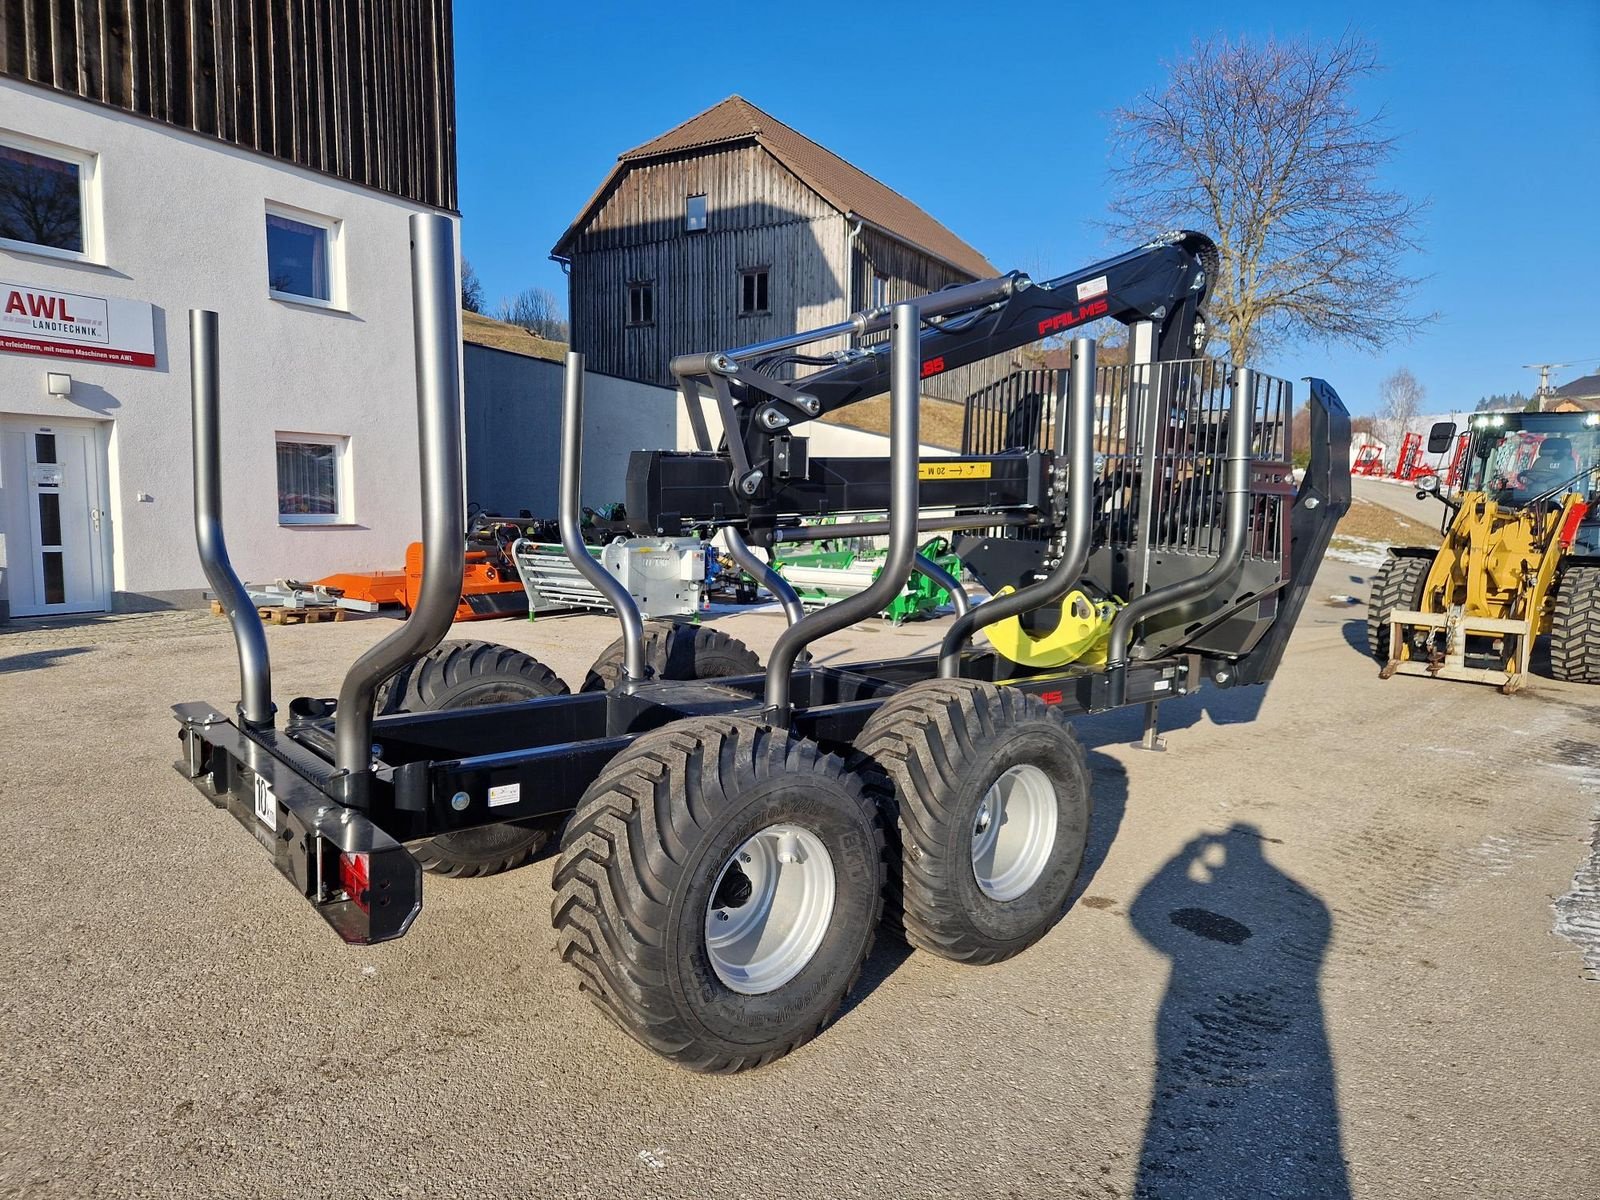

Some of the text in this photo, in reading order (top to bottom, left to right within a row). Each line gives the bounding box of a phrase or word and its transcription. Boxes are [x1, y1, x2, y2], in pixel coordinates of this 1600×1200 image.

[5, 290, 75, 322] AWL
[1038, 300, 1108, 334] PALMS
[33, 320, 97, 336] LANDTECHNIK
[5, 341, 43, 351] erleichtern,
[44, 346, 54, 354] mit
[55, 347, 75, 355] neuen
[75, 348, 108, 358] Maschinen
[120, 353, 134, 362] AWL
[921, 356, 944, 376] .85
[936, 467, 946, 475] 20
[257, 777, 266, 815] 10
